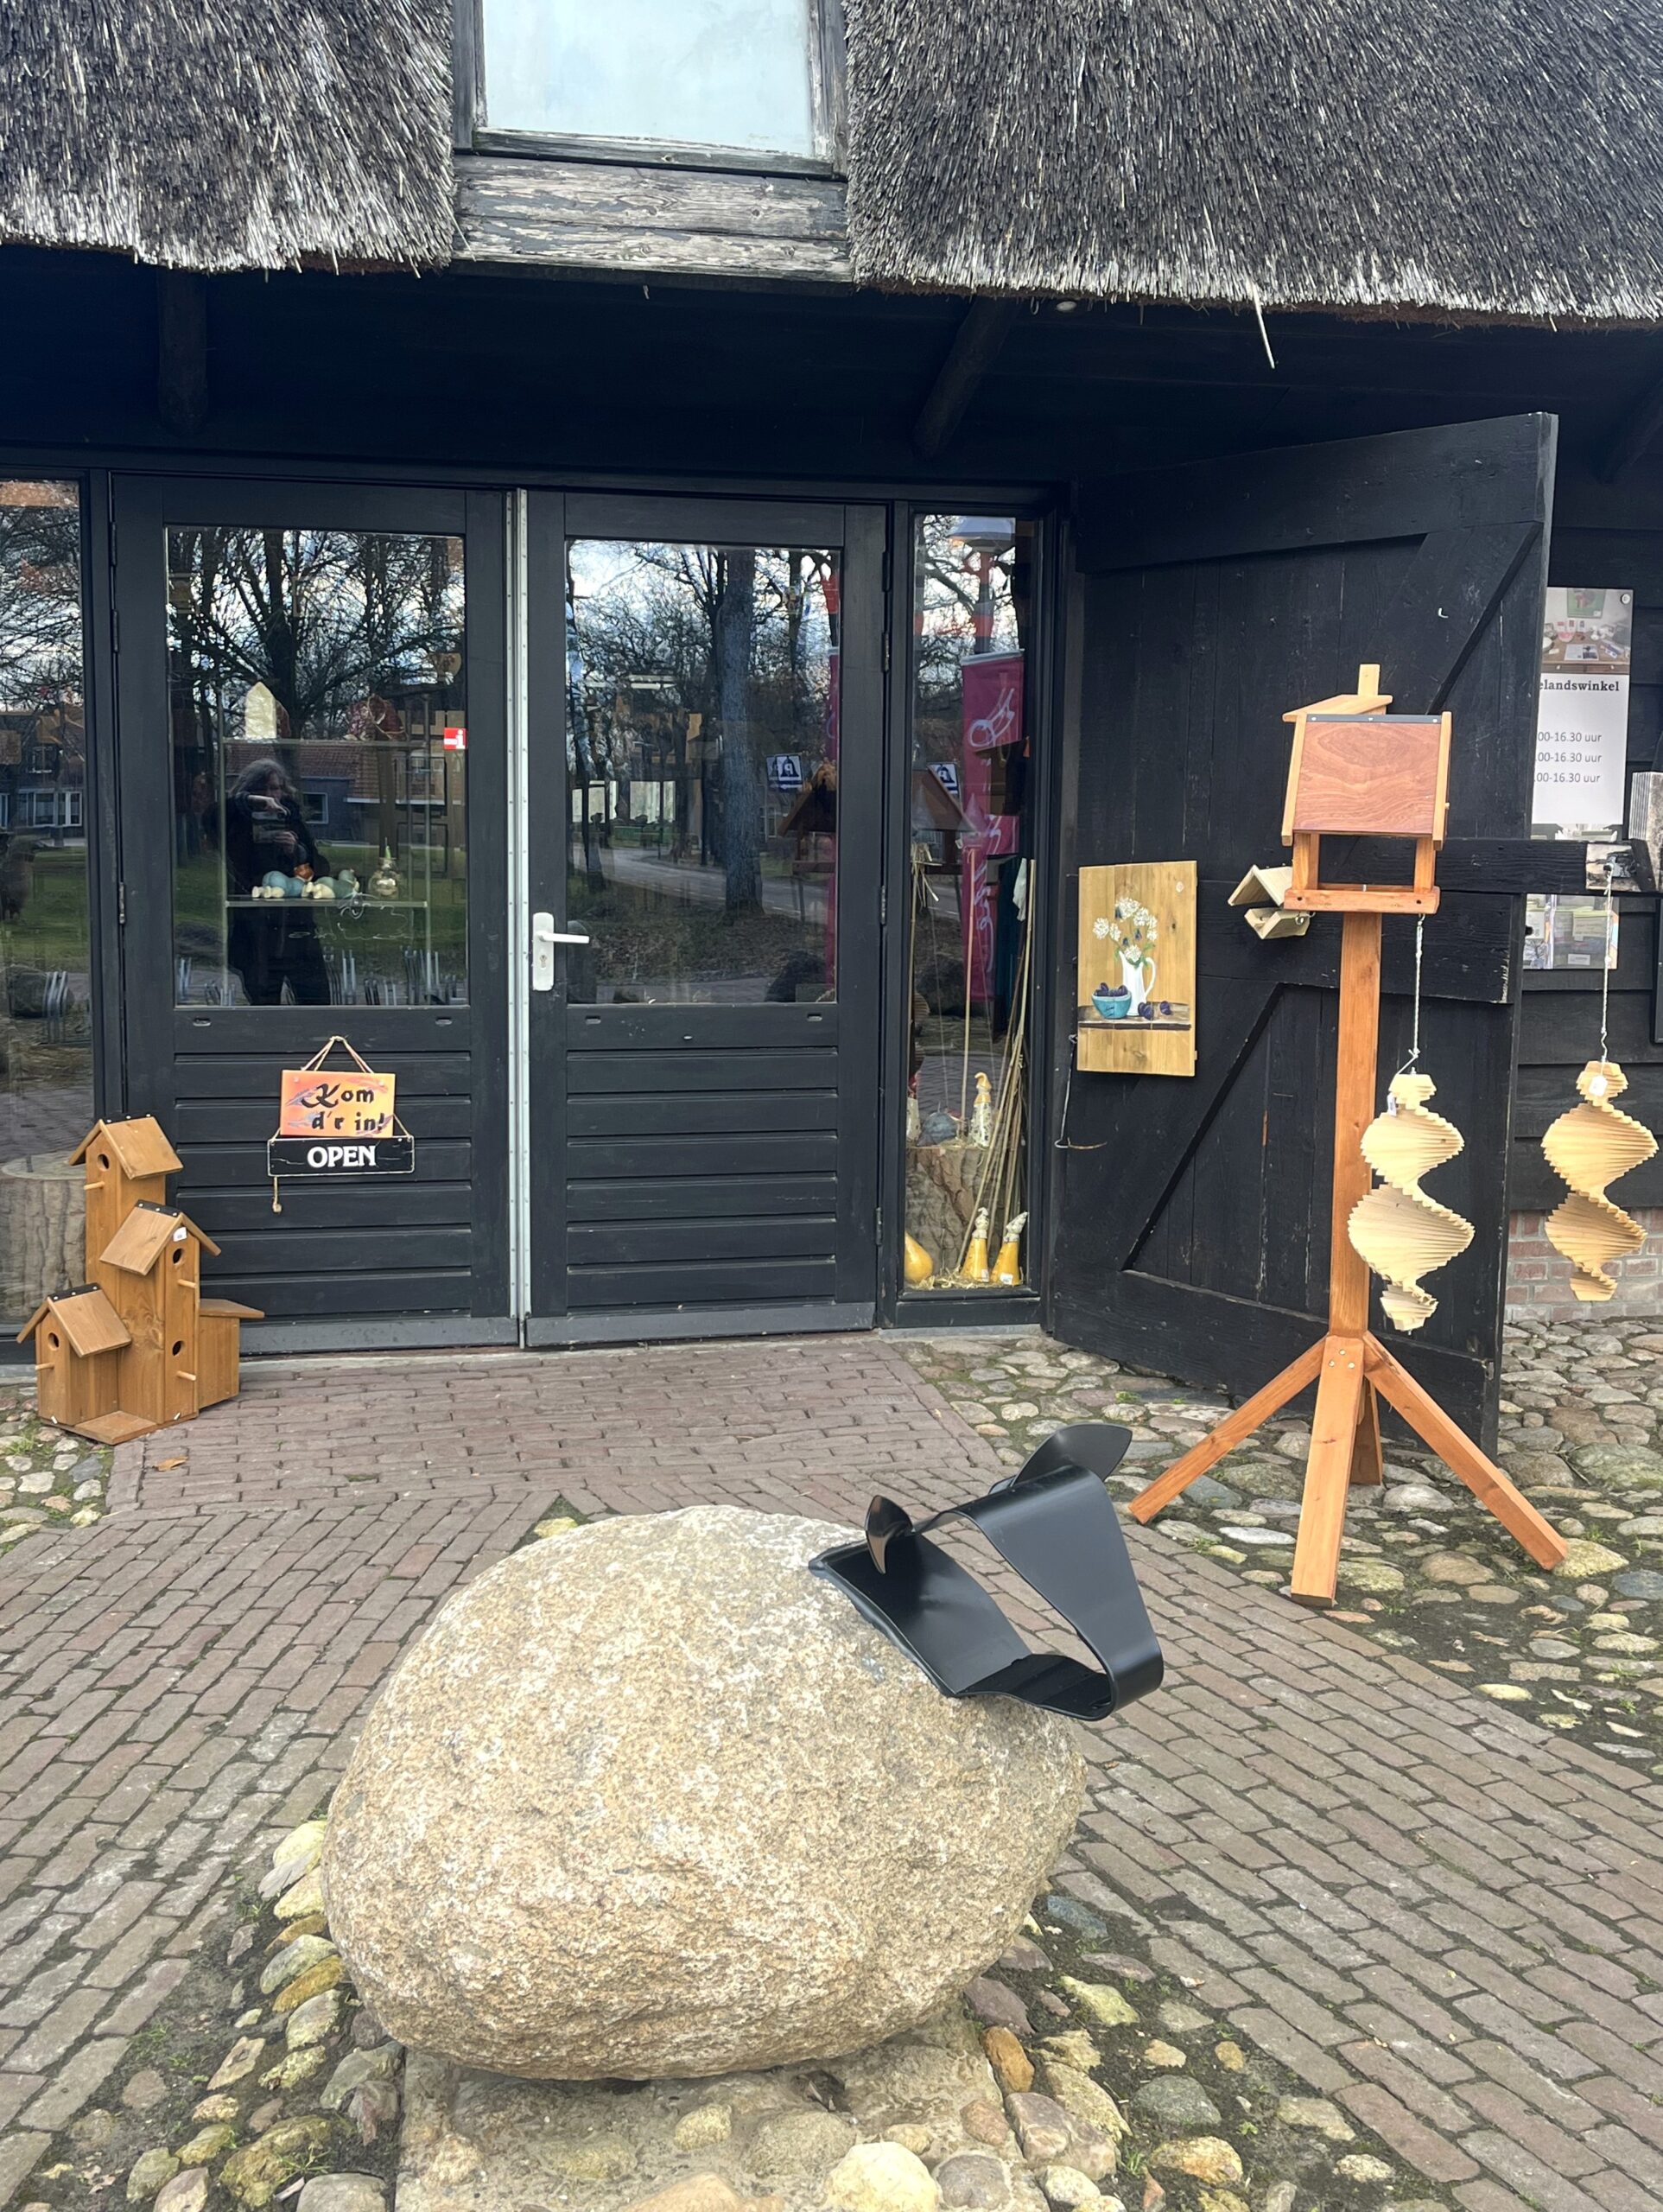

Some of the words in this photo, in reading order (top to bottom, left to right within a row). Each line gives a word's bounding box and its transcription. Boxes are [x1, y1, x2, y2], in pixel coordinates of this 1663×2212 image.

[301, 1083, 374, 1109] Kom
[354, 1111, 384, 1132] in!
[307, 1146, 377, 1168] OPEN
